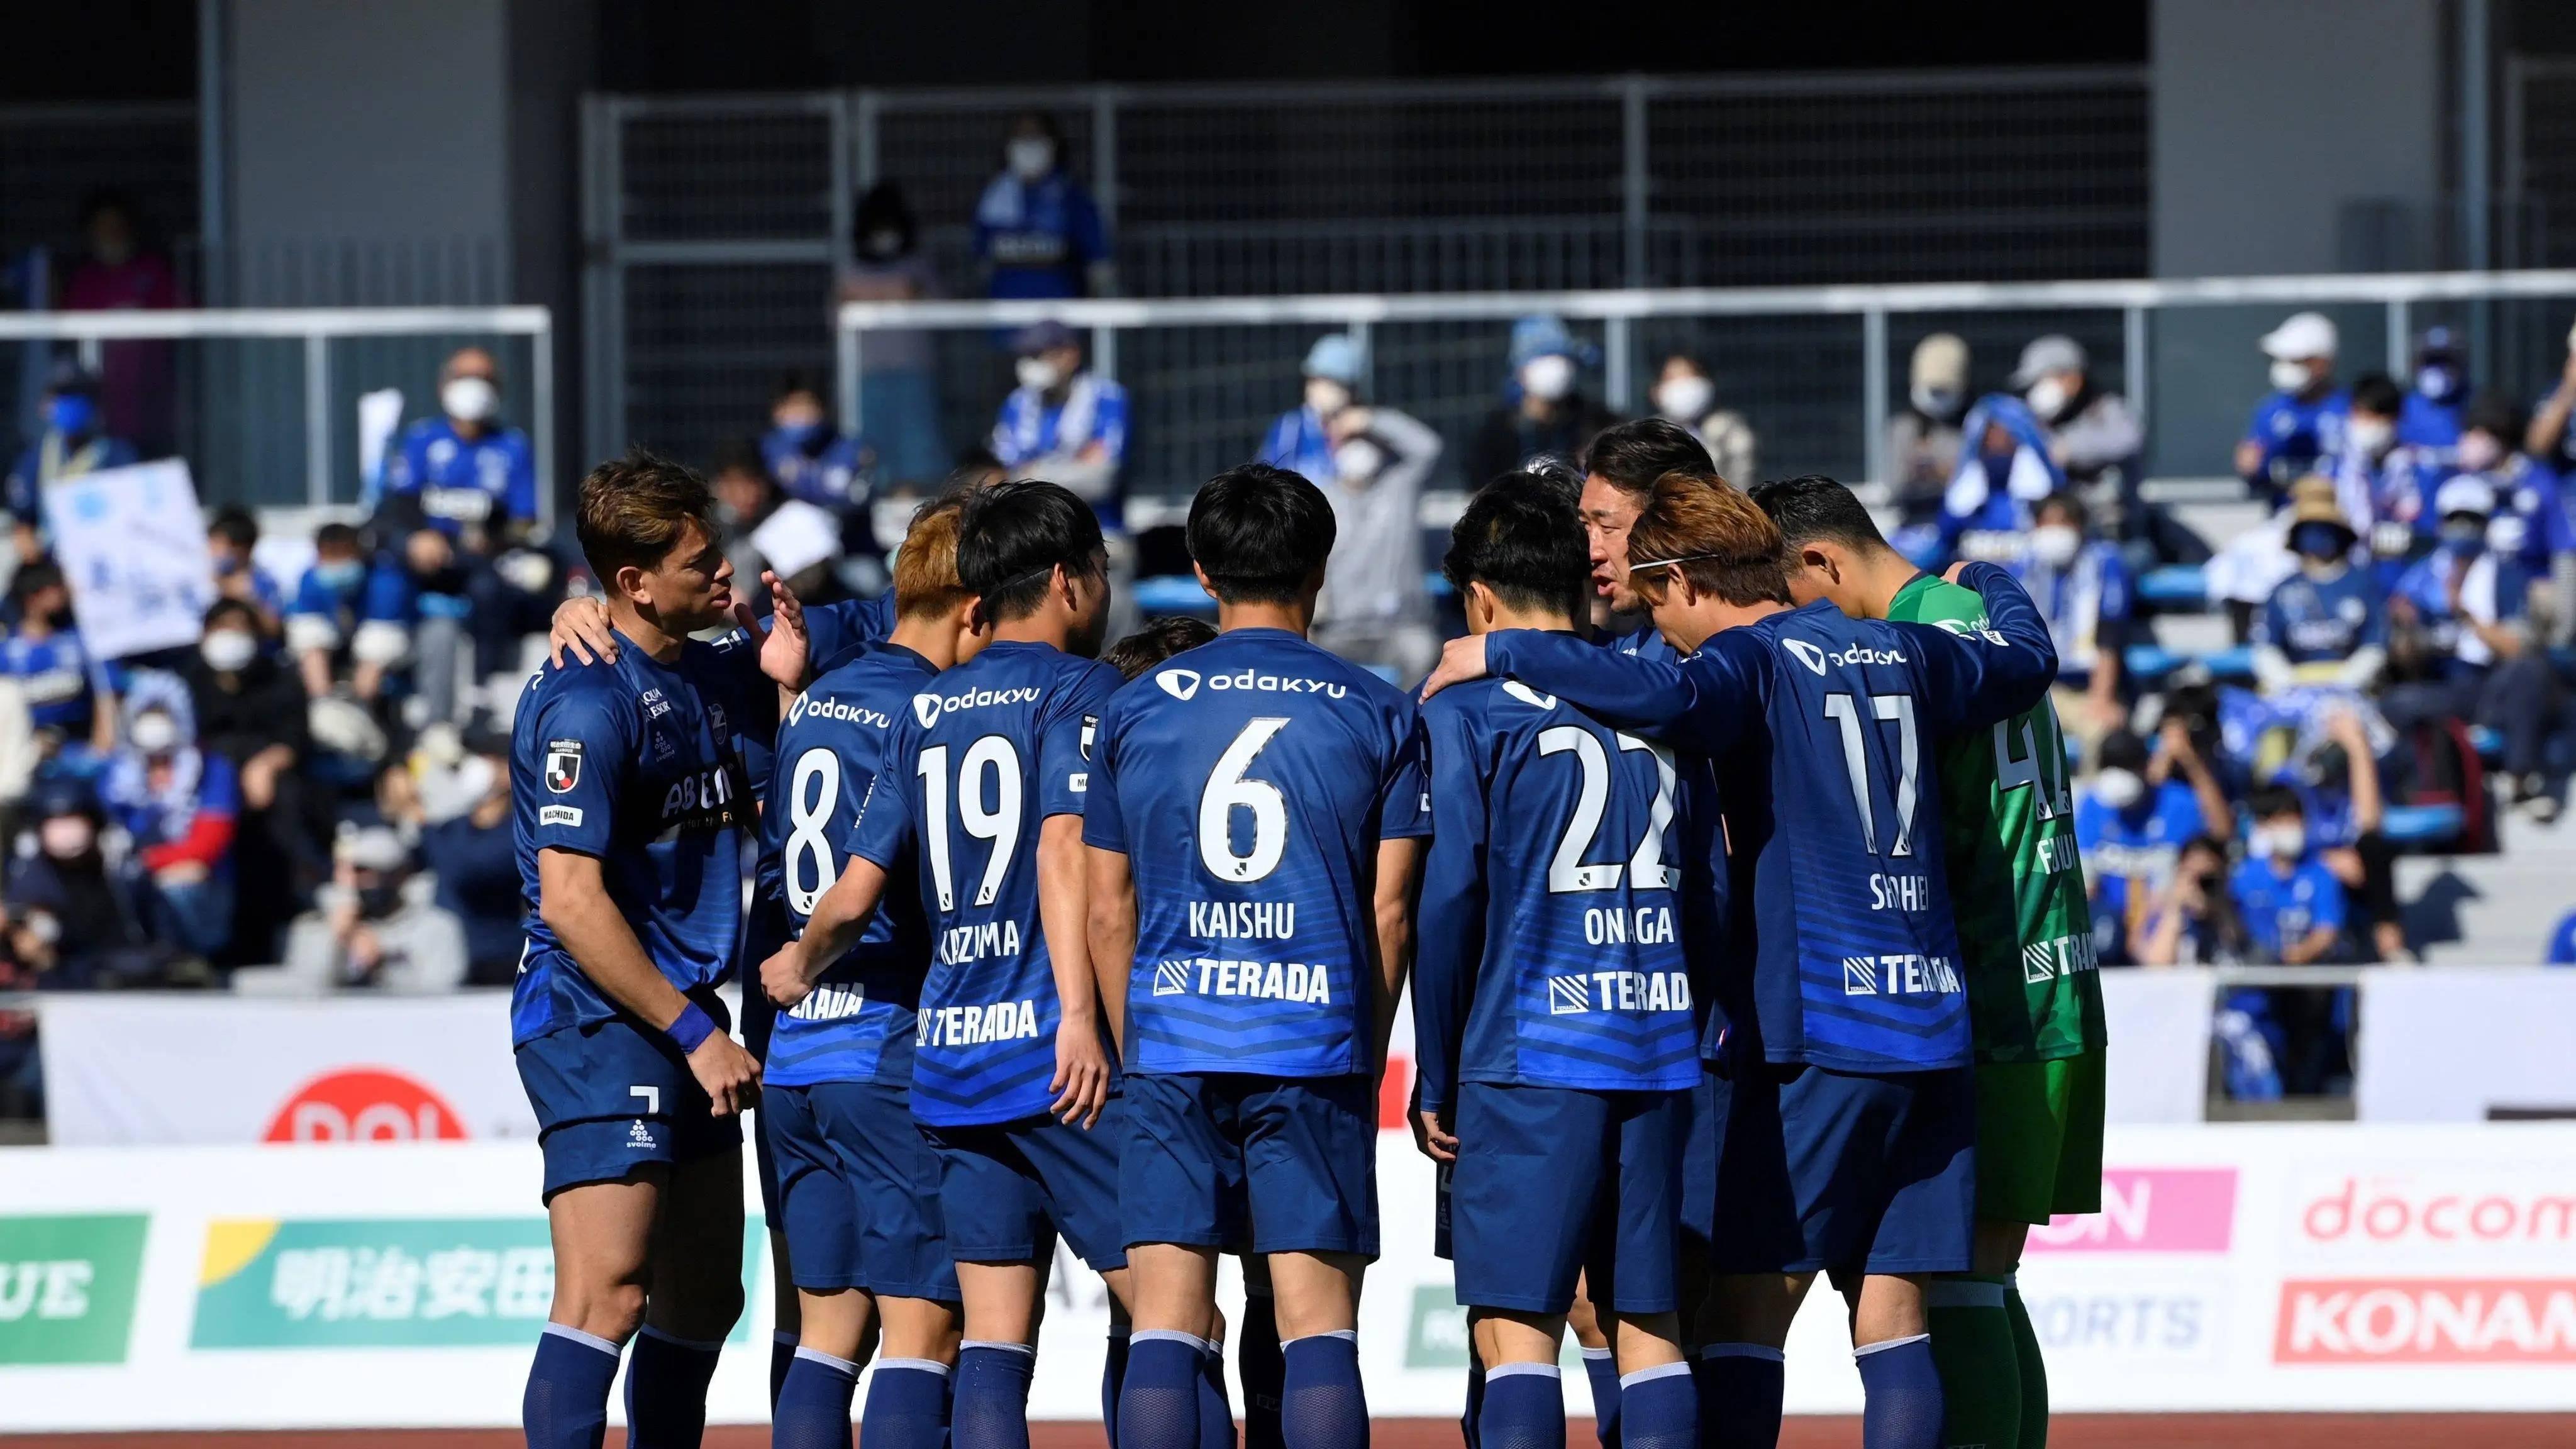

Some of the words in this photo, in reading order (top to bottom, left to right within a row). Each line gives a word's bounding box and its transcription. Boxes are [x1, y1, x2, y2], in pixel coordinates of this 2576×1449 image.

[944, 687, 1040, 713] odakyu
[1209, 669, 1346, 698] odakyu
[808, 696, 891, 728] odakyu
[1824, 694, 1918, 857] 17
[544, 810, 574, 820] MACHIDA
[1199, 717, 1291, 884] 6
[1538, 726, 1682, 893] 22
[785, 748, 839, 915] 8
[917, 736, 1022, 912] 19
[1189, 901, 1295, 939] KAISHU
[1585, 907, 1674, 945] ONAGA
[1196, 958, 1330, 1004] TERADA
[1592, 971, 1694, 1011] TERAD
[2026, 1295, 2202, 1347] ORTS
